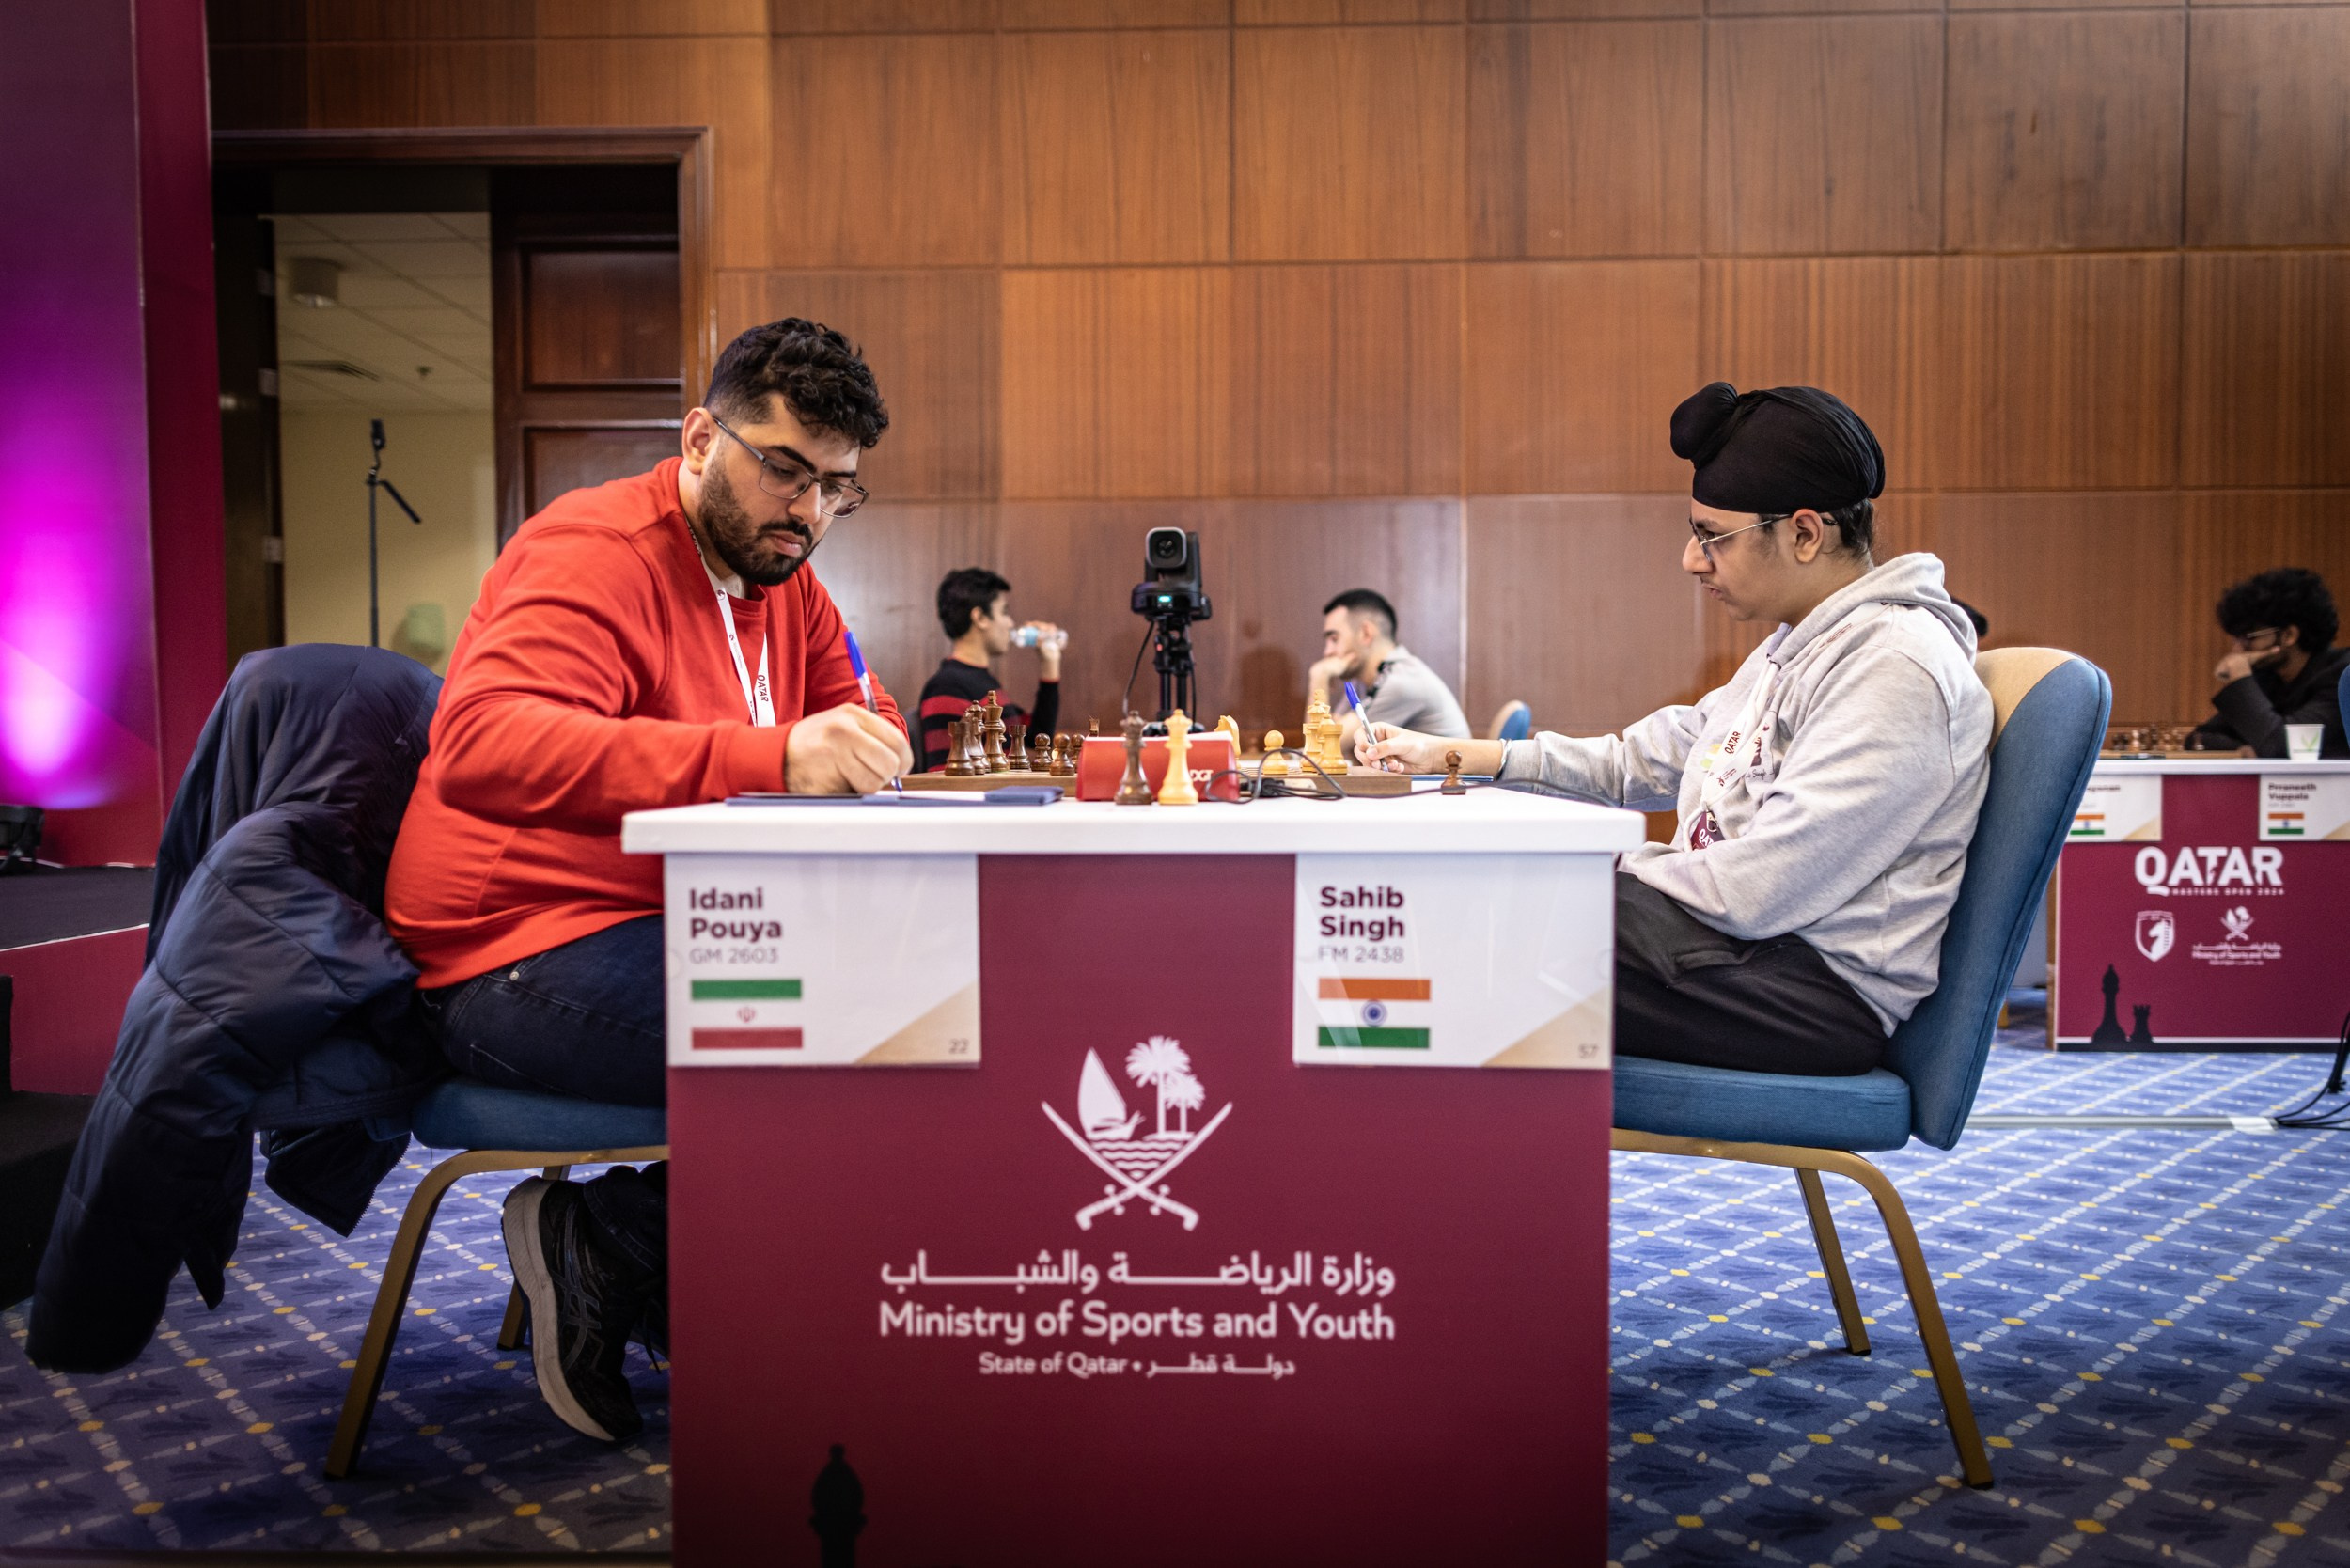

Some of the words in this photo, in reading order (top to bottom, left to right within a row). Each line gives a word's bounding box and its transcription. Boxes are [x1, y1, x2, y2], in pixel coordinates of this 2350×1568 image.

[1725, 731, 1741, 754] QATAR
[1699, 828, 1715, 846] QAT
[2135, 846, 2284, 897] QATAR
[689, 886, 763, 910] Idani
[1320, 886, 1404, 909] Sahib
[690, 917, 782, 943] Pouya
[1320, 915, 1404, 941] Singh
[689, 948, 722, 964] GM
[728, 947, 779, 964] 2603
[1319, 946, 1348, 962] FM
[1355, 946, 1404, 963] 2438
[948, 1039, 969, 1055] 22
[1577, 1043, 1599, 1059] 57
[1321, 1255, 1396, 1297] وزارة
[879, 1301, 1025, 1345] Ministry
[1035, 1299, 1074, 1336] of
[1082, 1300, 1204, 1345] Sports
[1213, 1301, 1277, 1337] and
[1287, 1302, 1395, 1340] Youth
[979, 1351, 1036, 1374] State
[1040, 1351, 1064, 1374] of
[1067, 1351, 1129, 1379] Qatar
